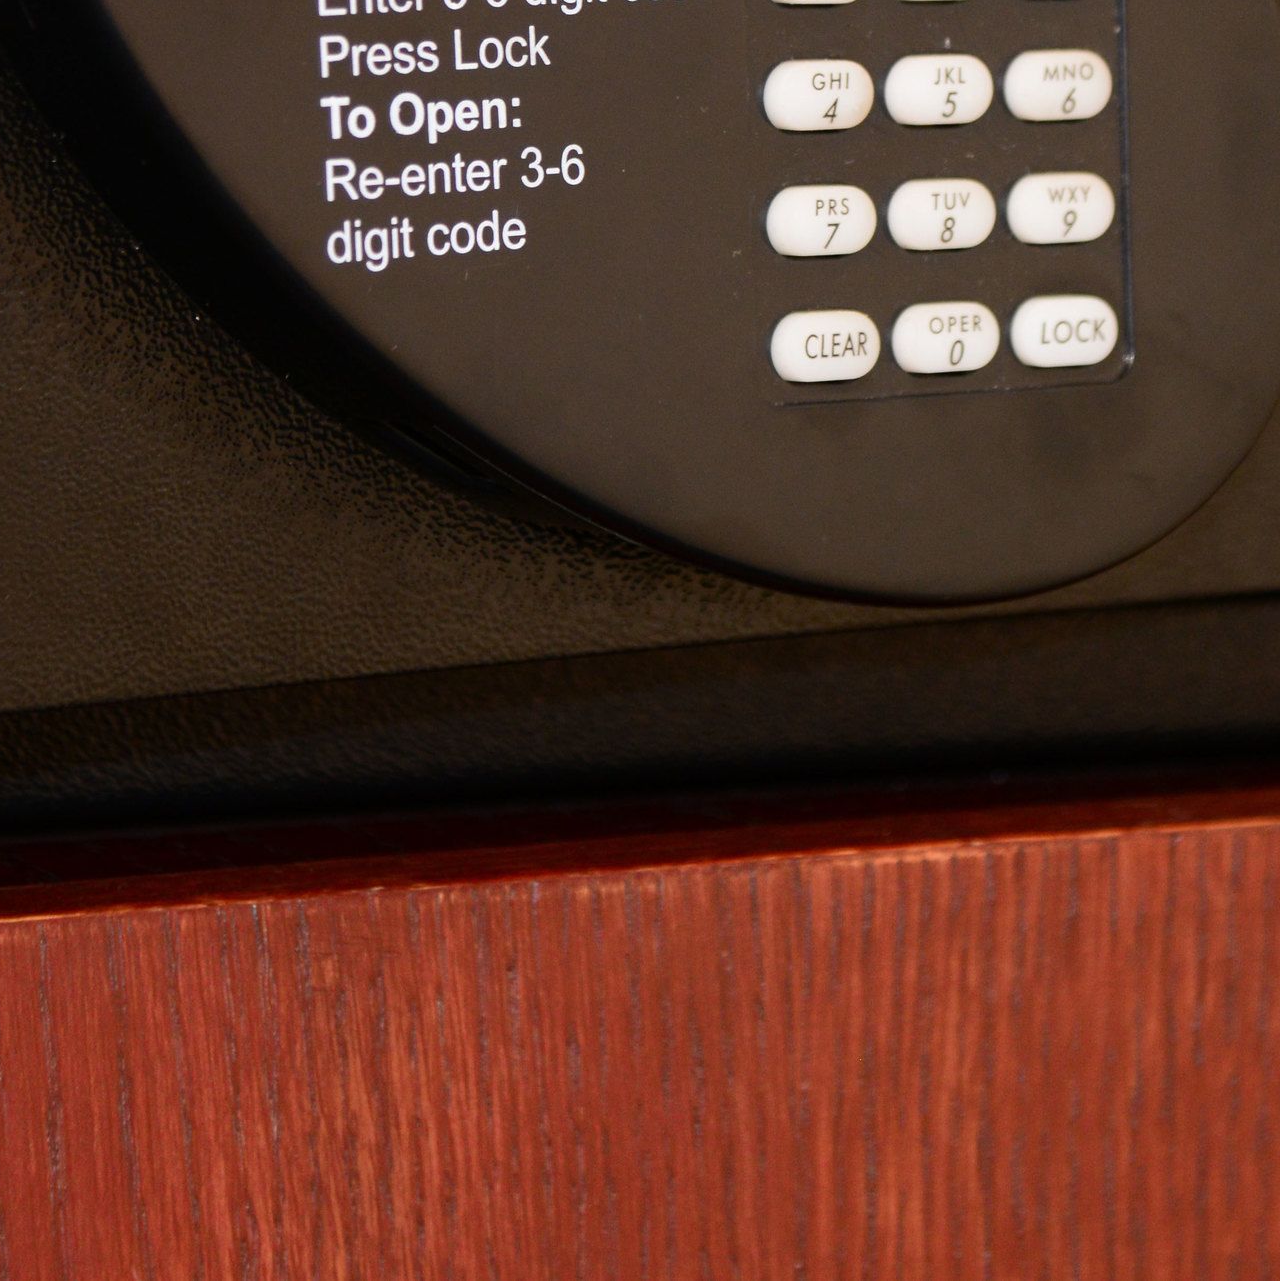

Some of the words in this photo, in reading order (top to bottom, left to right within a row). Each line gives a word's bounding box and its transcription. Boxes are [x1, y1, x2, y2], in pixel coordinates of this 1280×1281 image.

[319, 34, 440, 79] Press
[453, 25, 552, 71] Lock
[812, 72, 849, 91] GHI
[934, 67, 967, 86] JKL
[1042, 63, 1095, 82] MNO
[822, 97, 839, 125] 4
[941, 91, 958, 119] 5
[1061, 88, 1077, 115] 6
[319, 95, 377, 140] To
[389, 91, 522, 145] Open:
[325, 152, 508, 202] Re-enter
[520, 143, 586, 189] 3-6
[815, 197, 850, 216] PRS
[931, 191, 972, 212] TUV
[1047, 185, 1092, 205] WXY
[823, 222, 841, 250] 7
[940, 216, 956, 244] 8
[1062, 210, 1078, 239] 9
[326, 216, 416, 273] digit
[426, 209, 527, 256] code
[928, 314, 984, 335] OPER
[1041, 319, 1105, 345] LOCK
[804, 331, 868, 360] CLEAR
[949, 339, 965, 367] 0
